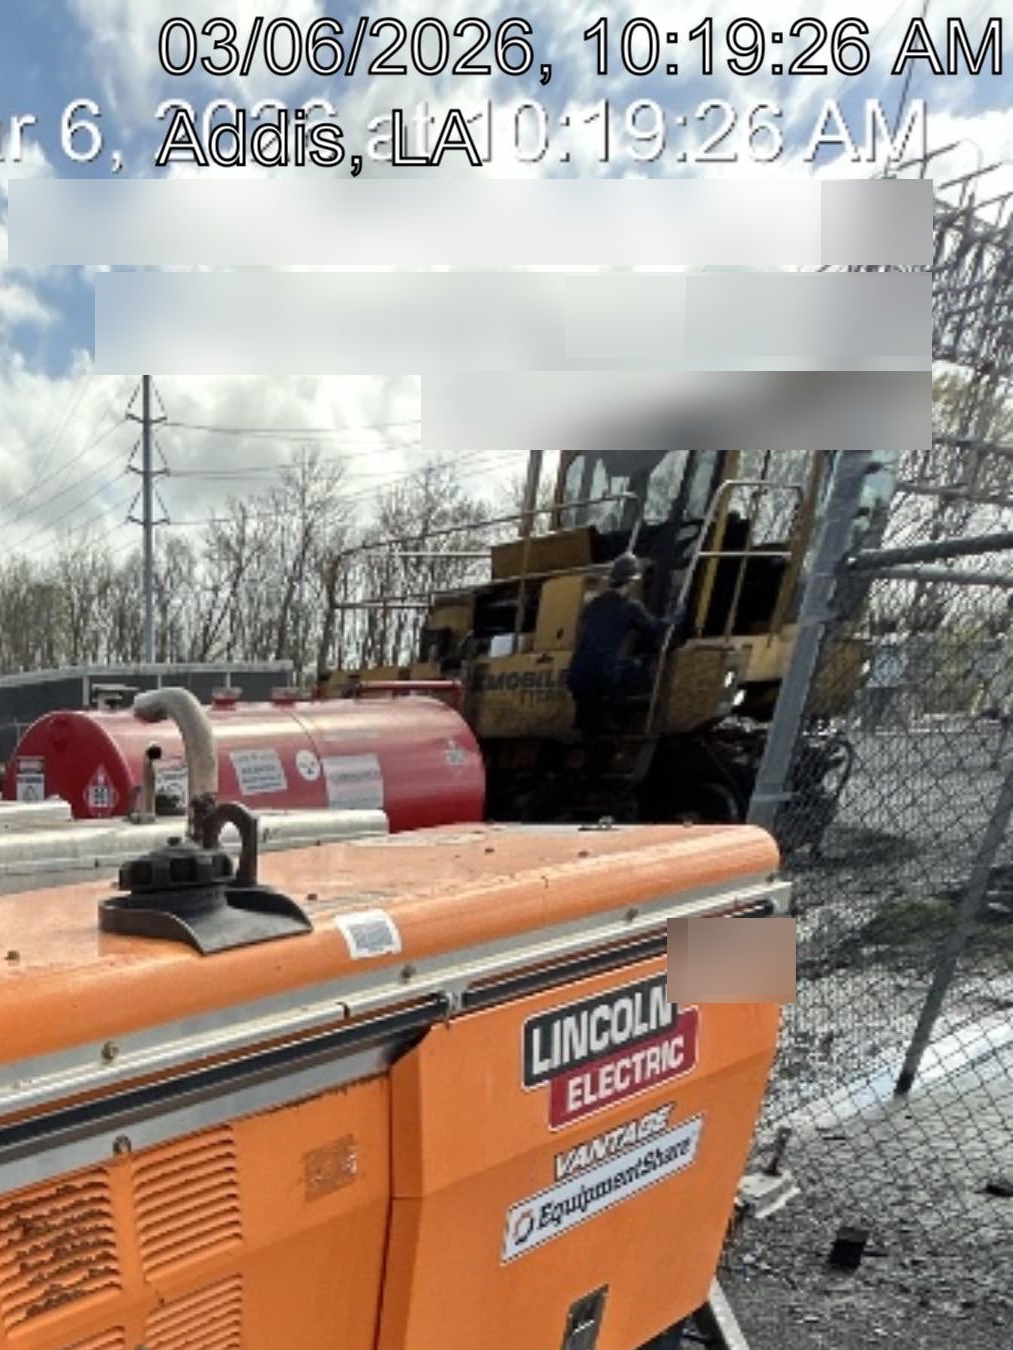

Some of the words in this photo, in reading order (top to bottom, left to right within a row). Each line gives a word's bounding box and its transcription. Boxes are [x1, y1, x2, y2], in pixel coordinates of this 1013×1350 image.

[531, 984, 674, 1076] LINCOLN
[565, 1034, 685, 1112] ELECTRIC
[537, 1137, 693, 1231] EquipmentShare
[555, 1103, 675, 1182] VANTAGE
